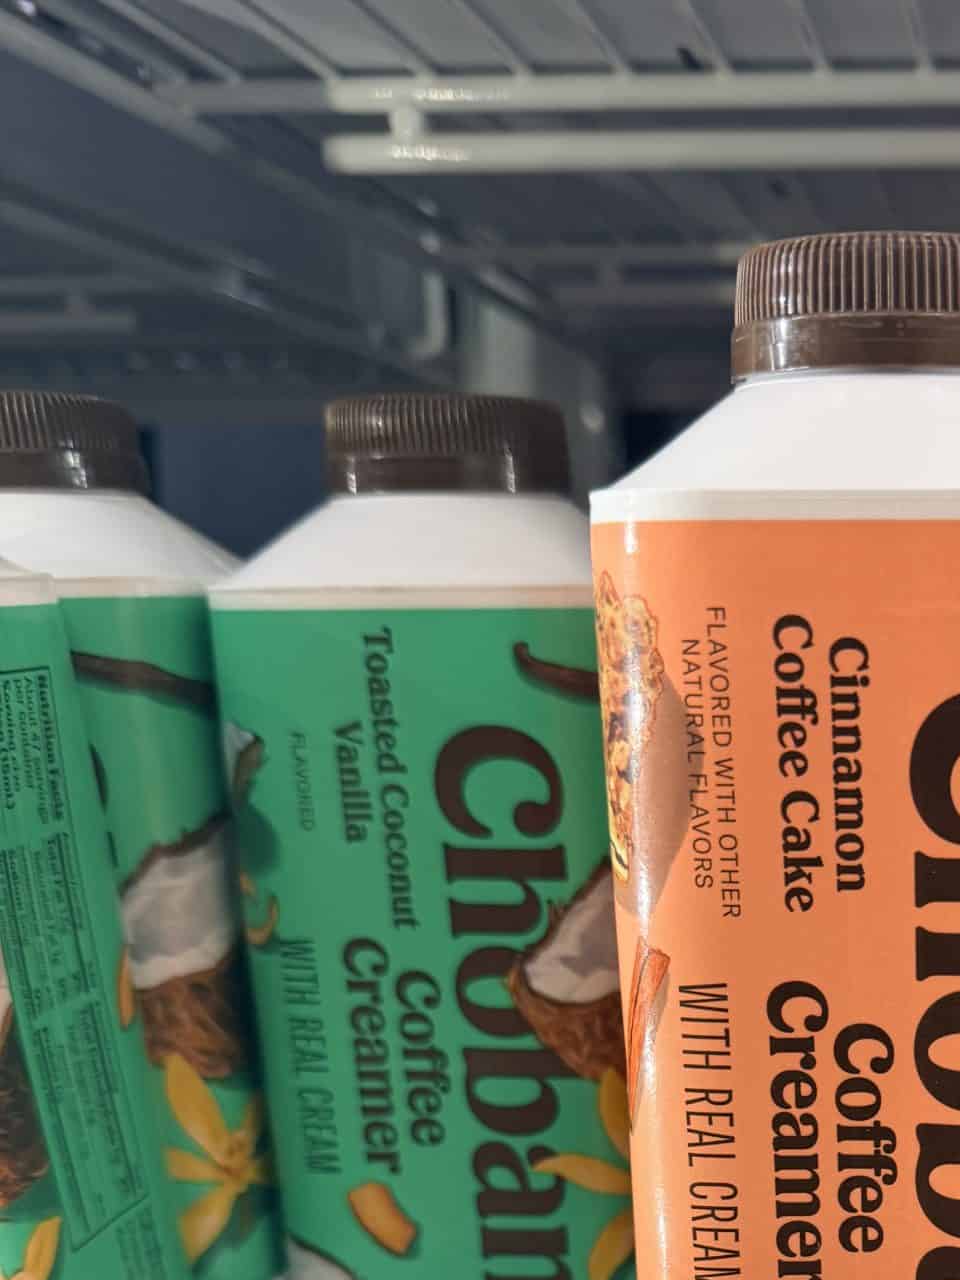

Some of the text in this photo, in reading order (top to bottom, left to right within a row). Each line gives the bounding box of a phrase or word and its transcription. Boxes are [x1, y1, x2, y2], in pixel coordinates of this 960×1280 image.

[333, 720, 373, 844] Vanilla
[362, 626, 420, 931] Toasted Coconut
[681, 639, 713, 890] NATURAL FLAVORS
[706, 606, 742, 918] FLAVORED WITH OTHER
[772, 614, 824, 913] Coffee Cake
[828, 636, 870, 893] Cinnamon
[288, 1017, 330, 1079] REAL
[298, 1087, 341, 1175] CREAM
[343, 938, 401, 1175] Creamer
[396, 970, 450, 1147] Coffee
[678, 983, 732, 1071] WITH
[684, 1087, 736, 1168] REAL
[833, 1022, 898, 1253] Coffee
